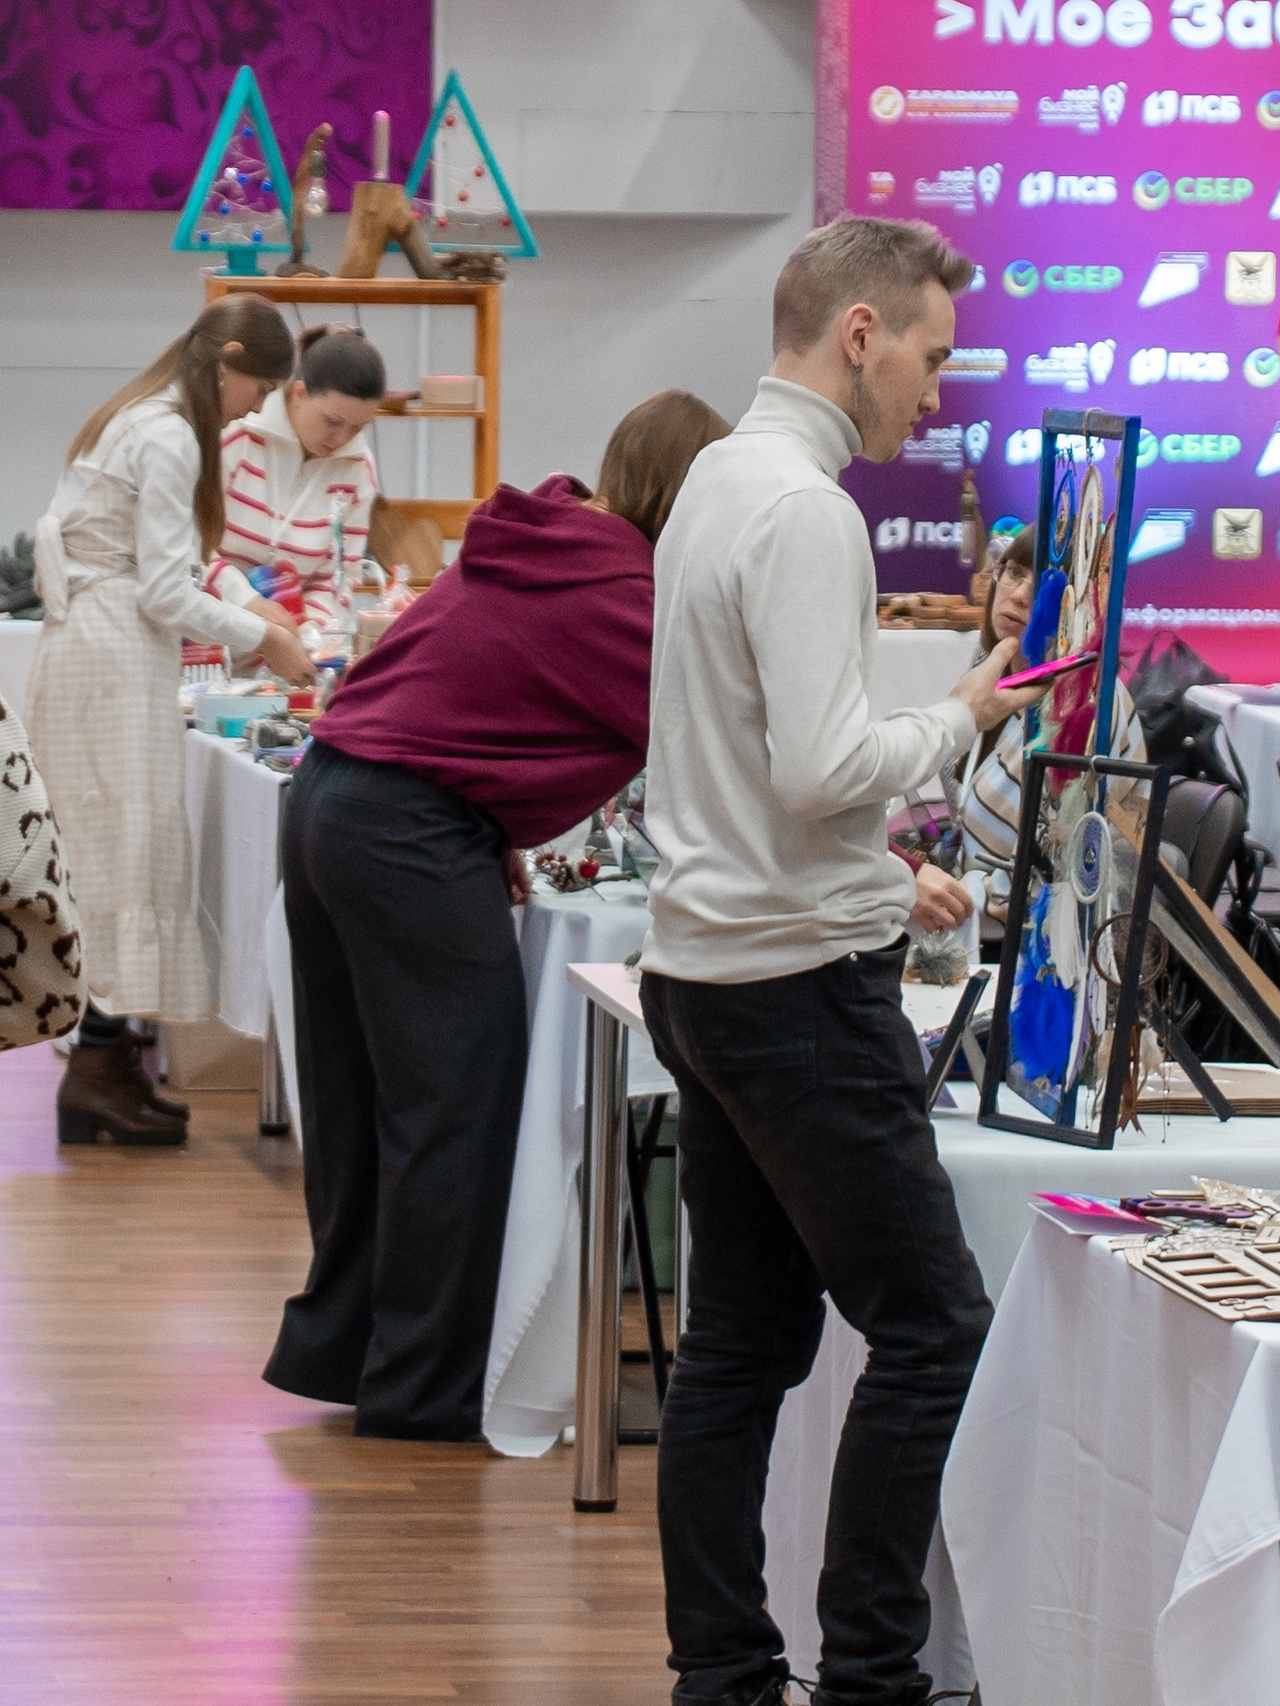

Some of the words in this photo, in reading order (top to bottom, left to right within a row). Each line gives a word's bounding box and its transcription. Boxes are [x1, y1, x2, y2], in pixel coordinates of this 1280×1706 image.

[1181, 95, 1241, 121] ПСБ
[1058, 176, 1117, 203] ПСБ
[1175, 177, 1253, 202] СБЕР
[1044, 265, 1123, 291] СБЕР
[1167, 351, 1230, 381] ПСБ
[1161, 434, 1242, 462] СБЕР
